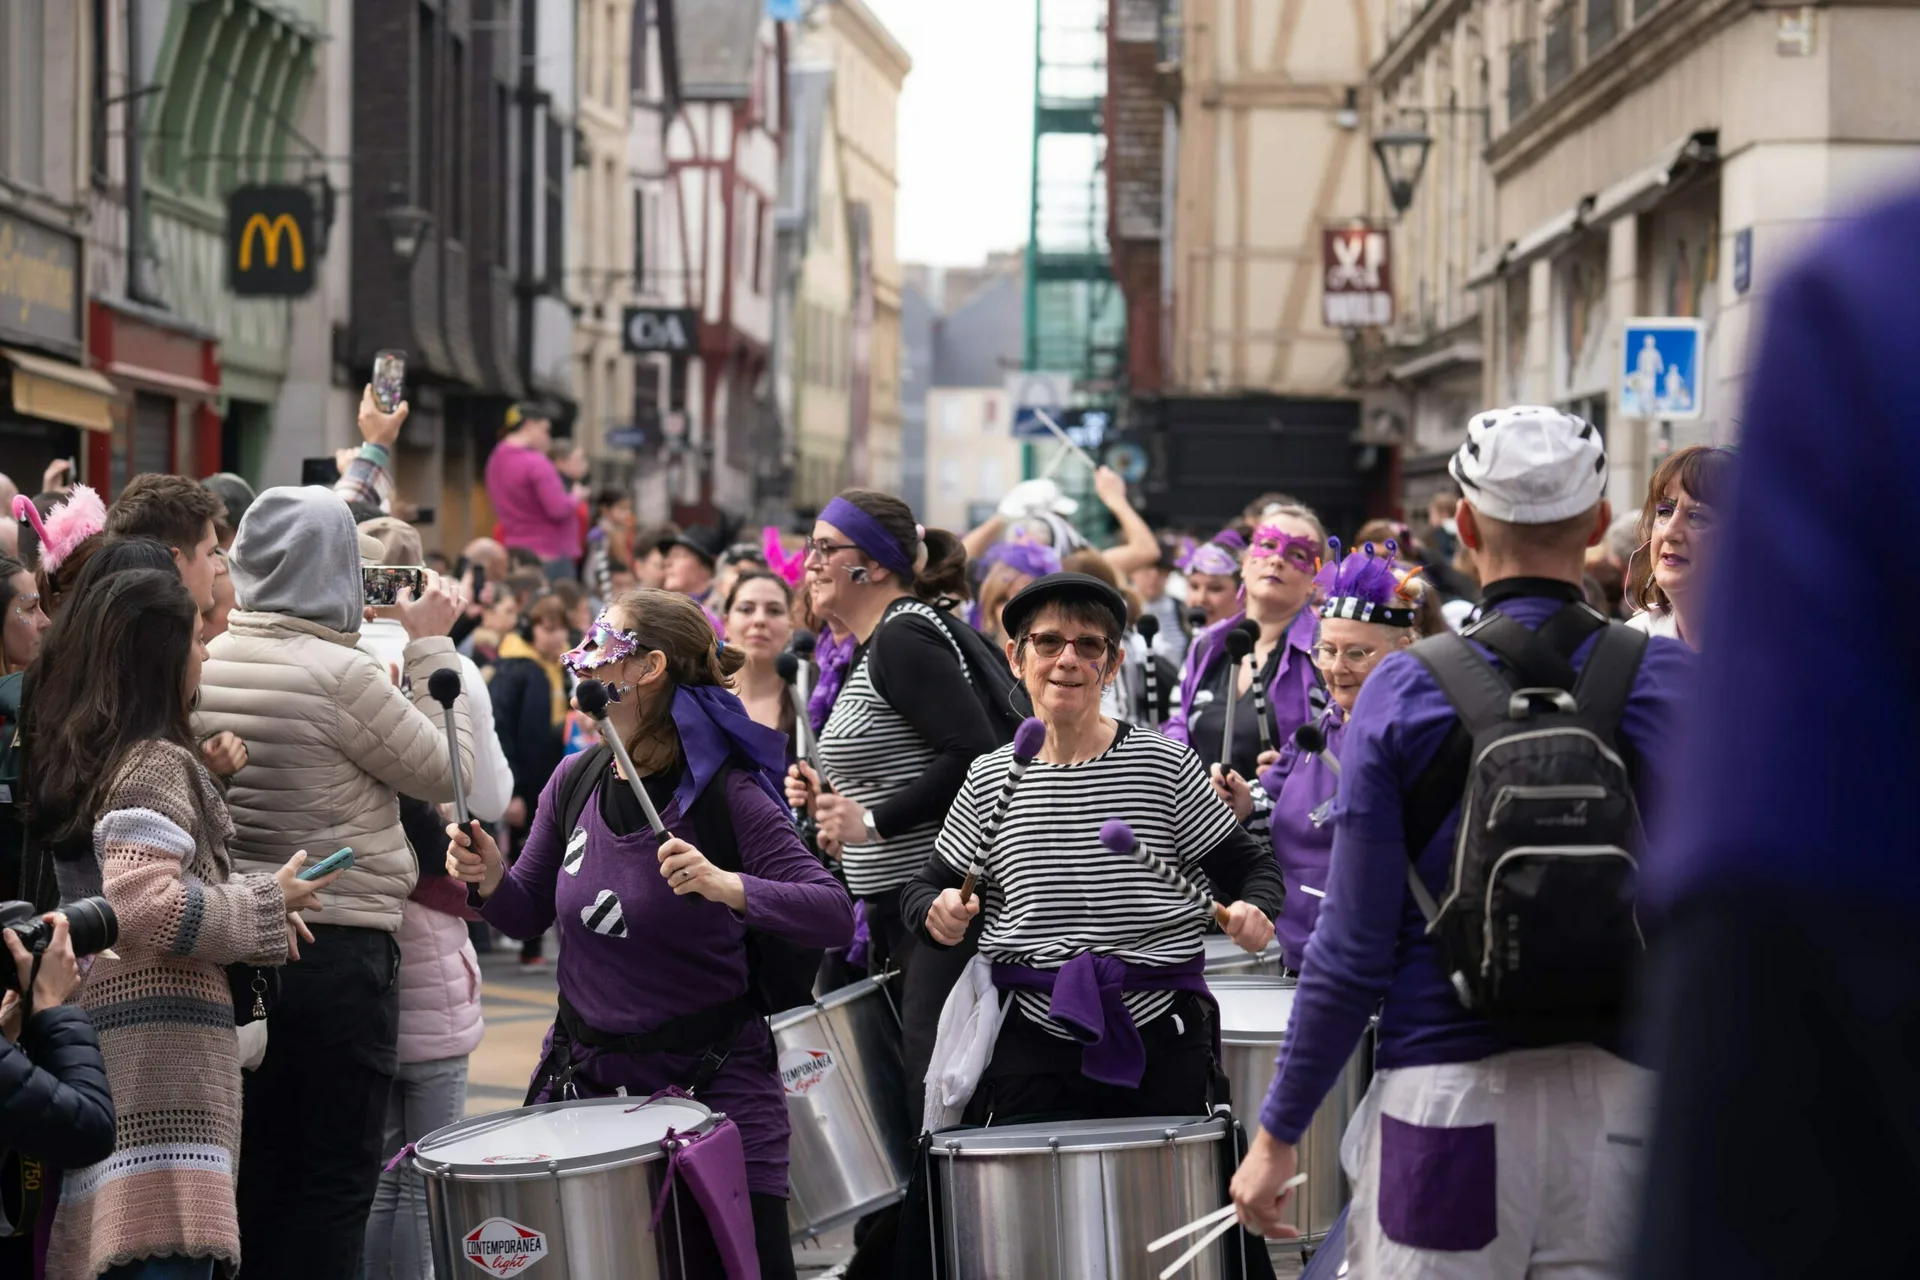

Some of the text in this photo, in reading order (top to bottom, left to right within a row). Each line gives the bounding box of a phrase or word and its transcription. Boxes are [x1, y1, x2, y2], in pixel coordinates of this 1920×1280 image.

[24, 1156, 41, 1190] 750
[466, 1236, 542, 1255] CONTEMPORÂNEA
[492, 1253, 530, 1276] light
